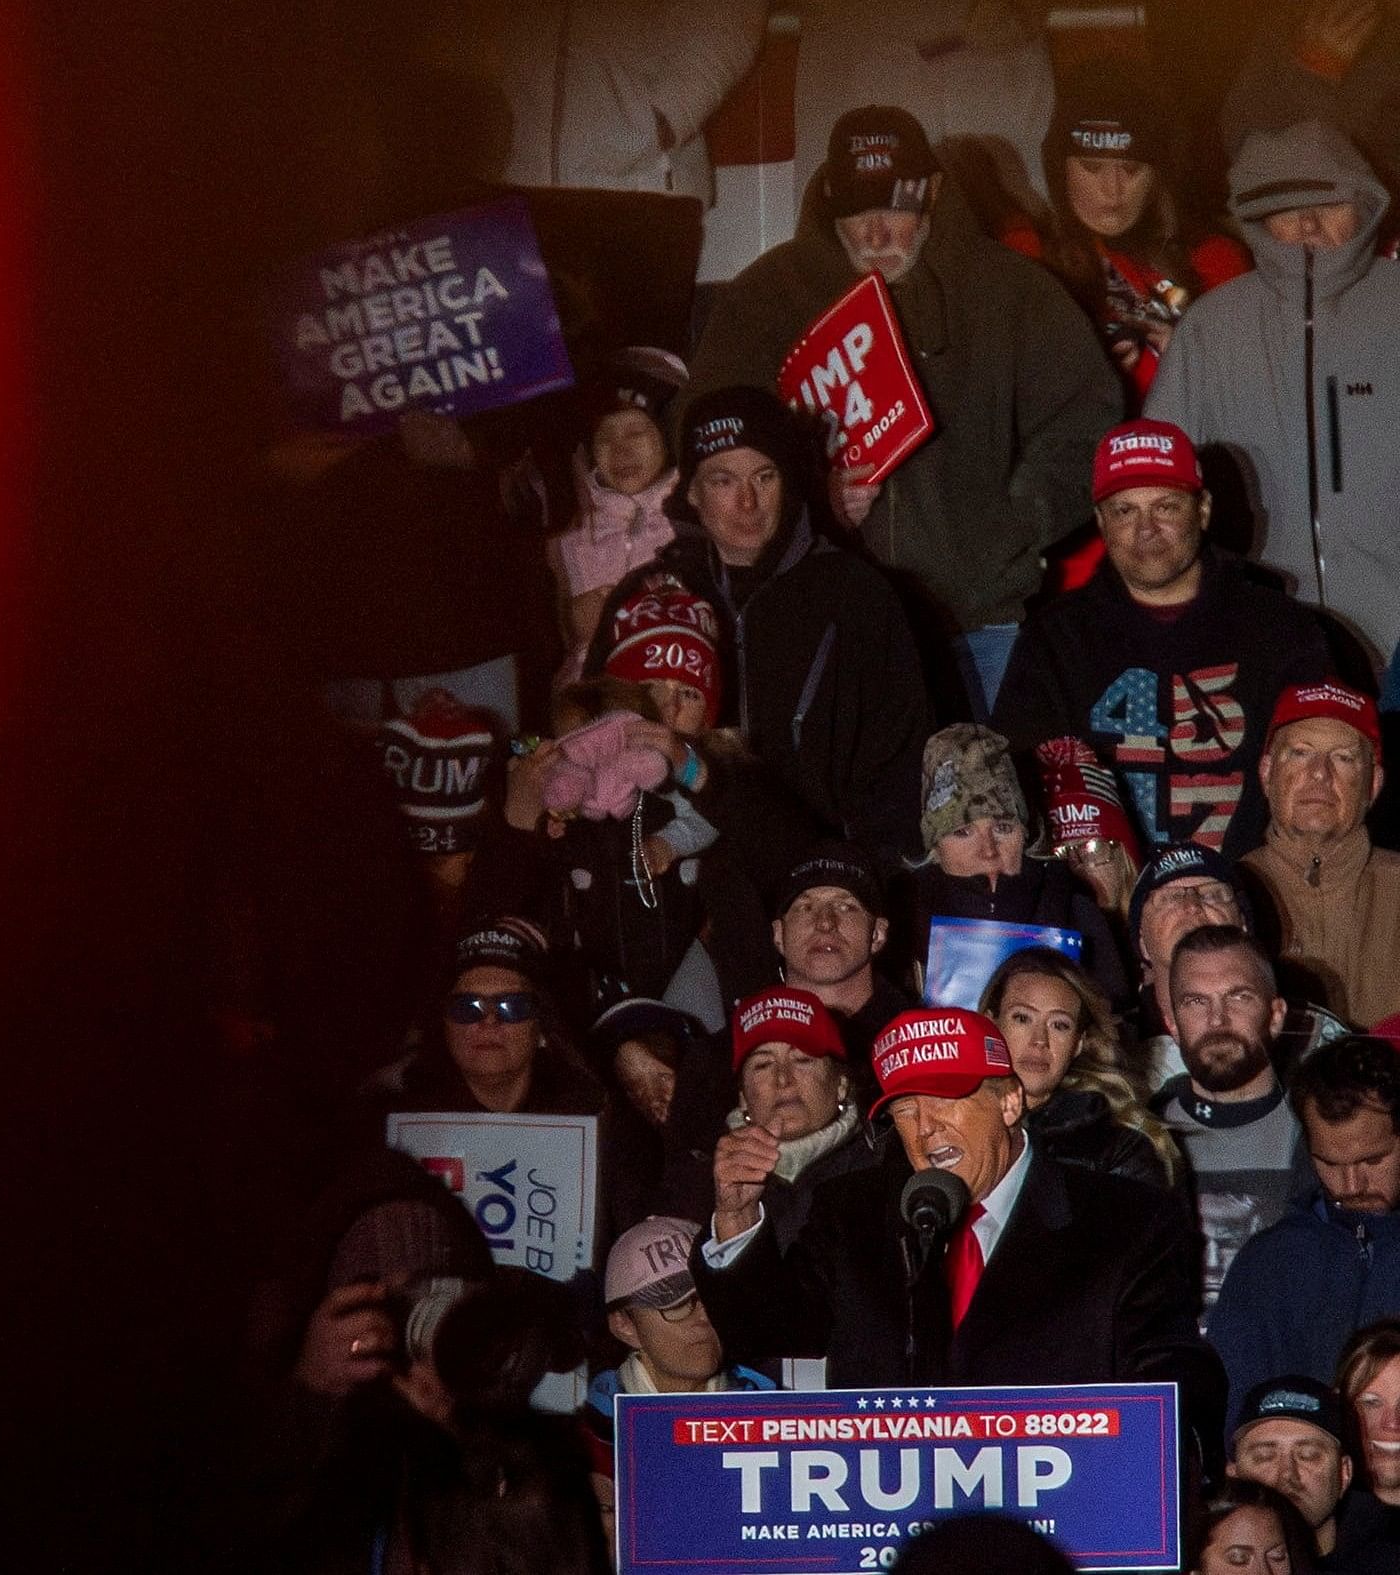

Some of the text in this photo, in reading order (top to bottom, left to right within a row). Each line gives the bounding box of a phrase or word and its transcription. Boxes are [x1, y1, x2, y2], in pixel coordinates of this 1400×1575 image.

[1070, 130, 1132, 150] TRUMP
[319, 236, 456, 298] MAKE
[294, 267, 509, 349] AMERICA
[331, 311, 484, 379] GREAT
[340, 346, 505, 421] AGAIN!
[822, 379, 875, 460] 24
[863, 399, 905, 449] 88022
[1109, 432, 1174, 455] Trump
[1089, 661, 1246, 763] 45
[1049, 804, 1100, 825] RUMP
[765, 997, 815, 1017] AMERICA
[776, 1009, 812, 1026] AGAIN
[897, 1018, 967, 1044] AMERICA
[912, 1042, 959, 1064] AGAIN
[525, 1168, 556, 1274] JOE B
[685, 1413, 1110, 1443] TEXT PENNSYLVANIA TO 88022
[722, 1446, 1073, 1514] TRUMP
[741, 1524, 800, 1541] MAKE
[806, 1522, 901, 1539] AMERICA
[859, 1546, 898, 1569] 20
